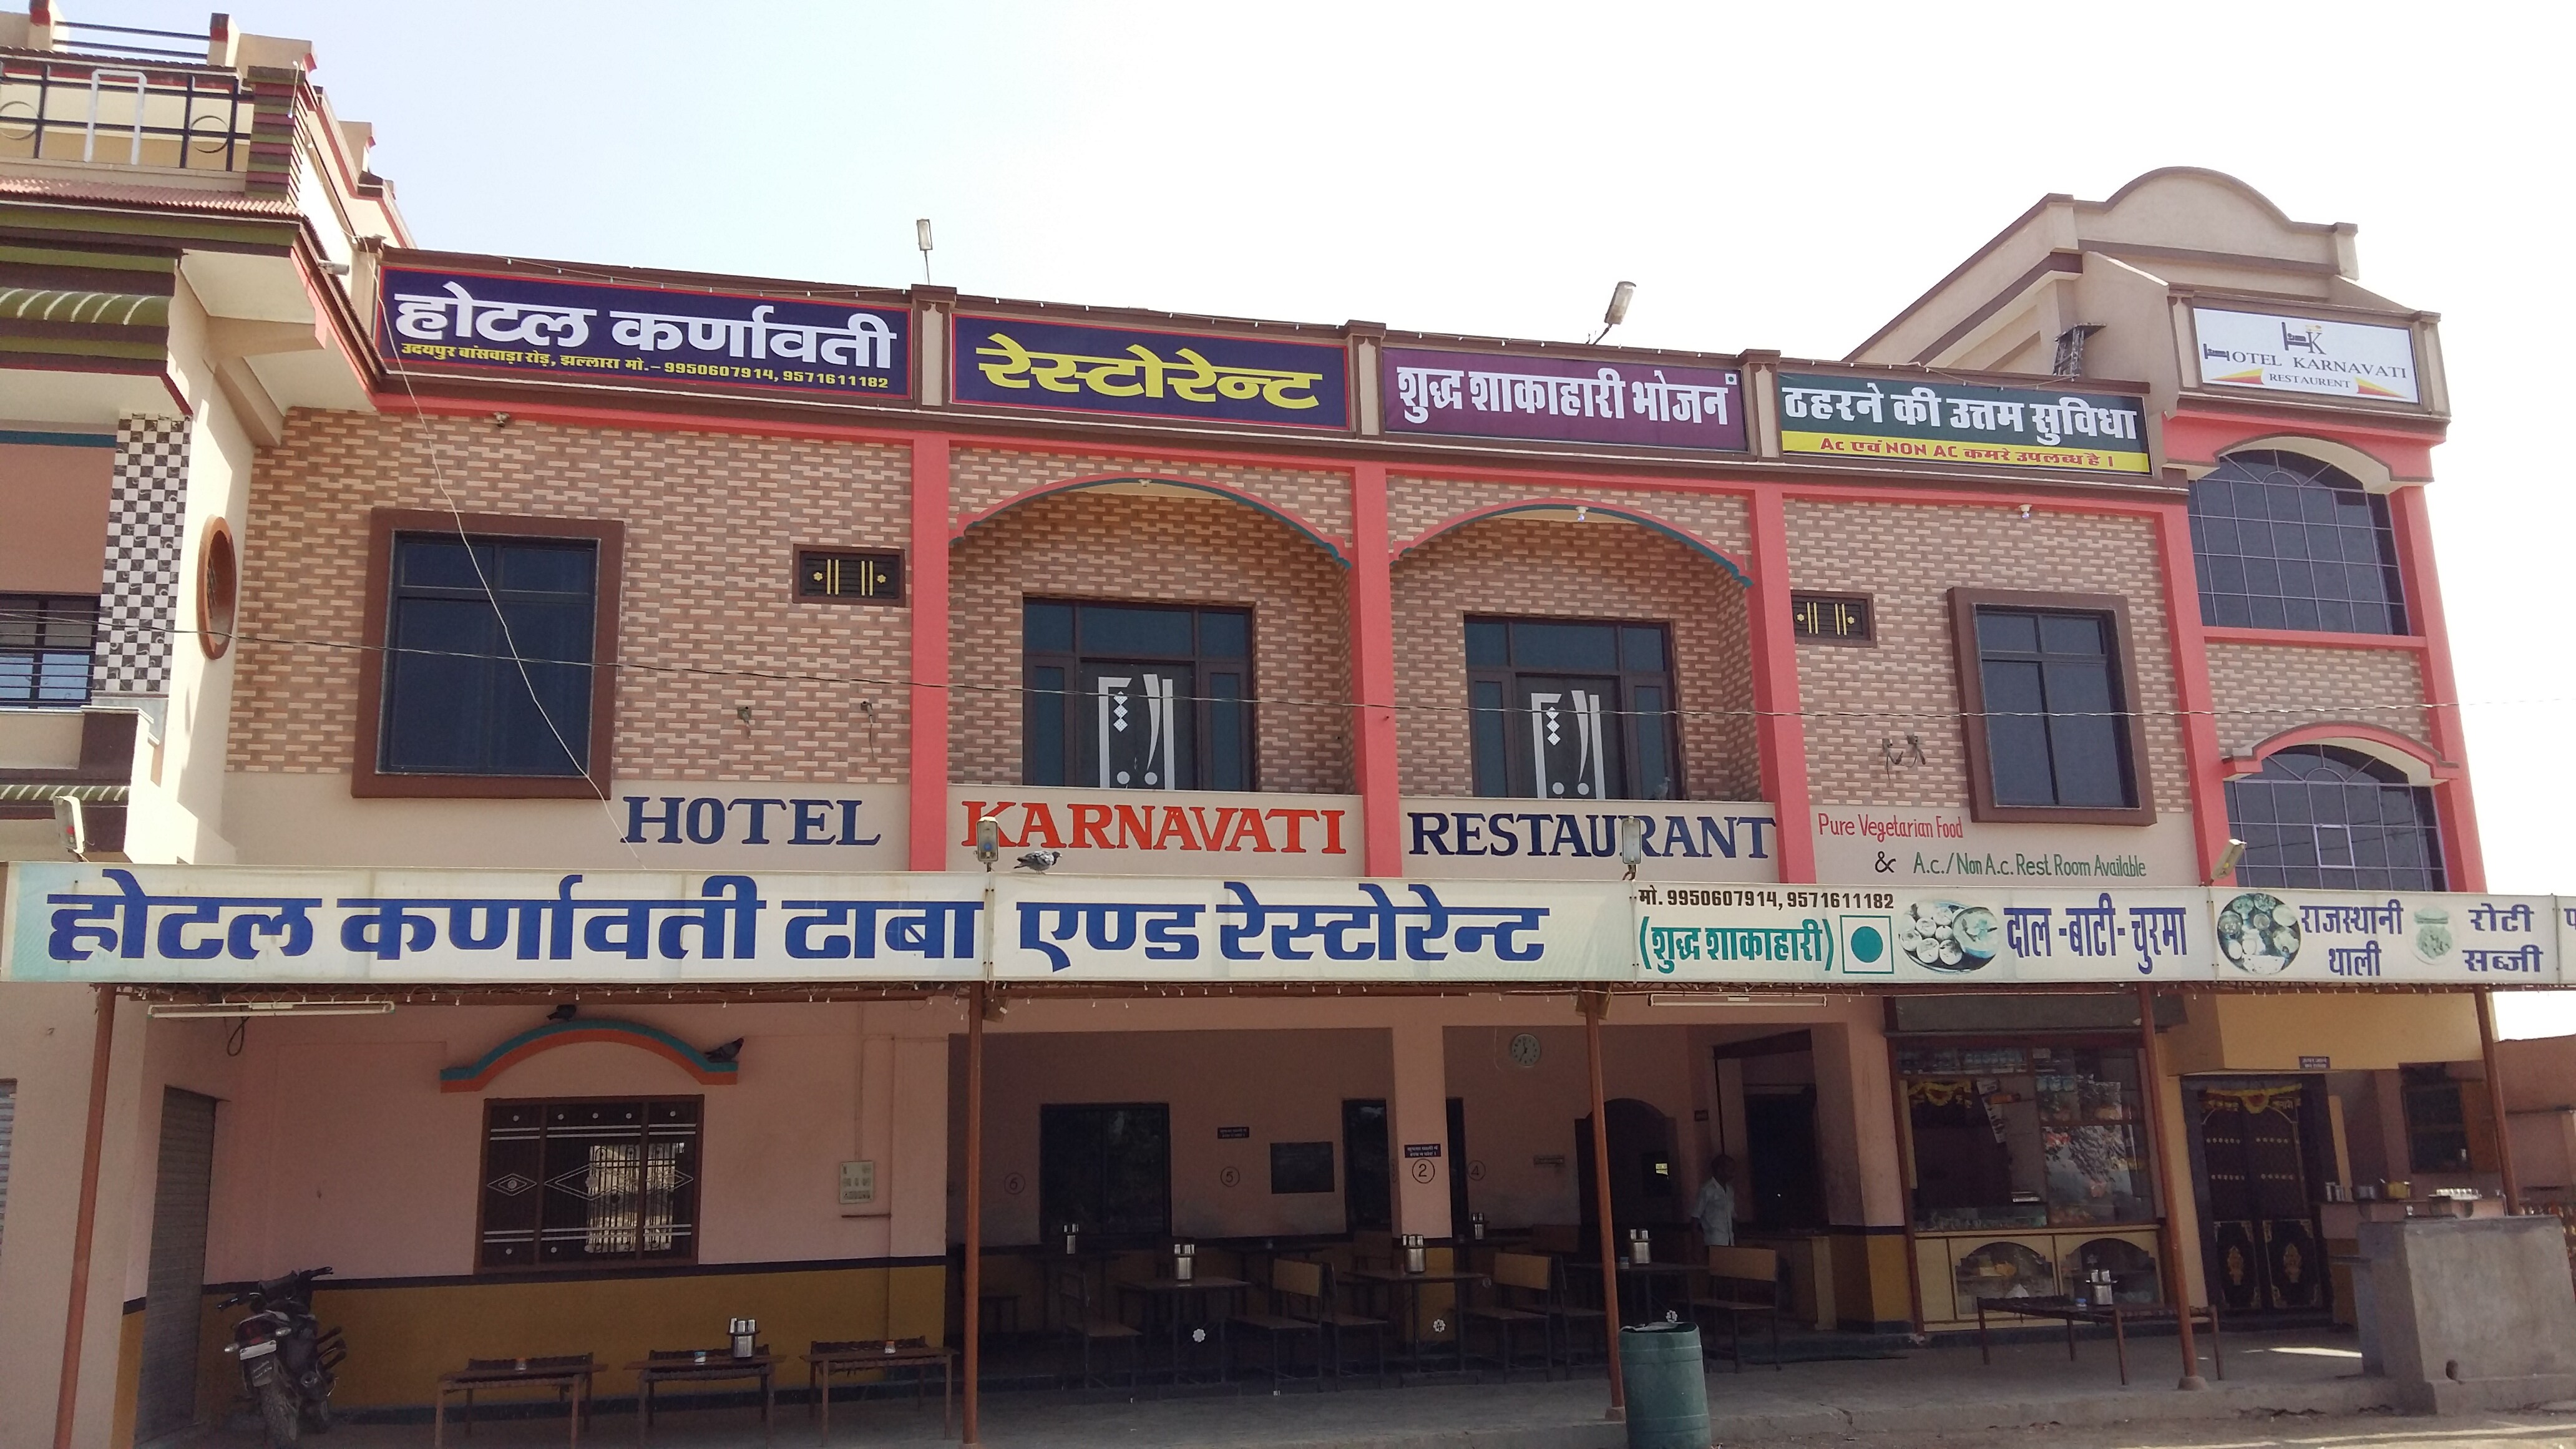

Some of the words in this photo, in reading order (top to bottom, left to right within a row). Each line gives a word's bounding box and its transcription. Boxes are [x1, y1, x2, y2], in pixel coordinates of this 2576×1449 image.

[394, 281, 597, 348] होटल
[609, 305, 897, 369] कर्णावती
[401, 342, 456, 361] उदयपुर
[458, 345, 523, 365] बांसवाड़ा
[560, 354, 620, 369] झल्लारा
[783, 371, 889, 389] 9571611182
[975, 333, 1324, 409] रेस्टोरेन्ट
[2292, 356, 2408, 379] KARNAVATI
[1396, 366, 1465, 424] शुद्ध
[1468, 367, 1626, 419] शाकाहारी
[1632, 370, 1729, 425] भोजन
[2269, 373, 2351, 389] RESTAURENT
[1781, 383, 1885, 424] ठहरने
[1890, 387, 1942, 427] की
[2029, 396, 2137, 446] सुविधा
[1850, 438, 1883, 455] एवं
[1885, 440, 1927, 457] NON
[1933, 444, 1959, 459] AC
[1963, 446, 2011, 462] कमरे
[2016, 450, 2084, 466] उपलब्ध
[619, 796, 882, 846] HOTEL
[961, 800, 1347, 854] KARNAVATI
[1407, 812, 1777, 859] RESTAURANT
[1818, 812, 1856, 837] Pure
[1858, 813, 1934, 842] Vegetarian
[1936, 816, 1964, 839] Food
[1874, 850, 1896, 874] &
[2016, 852, 2052, 876] Rest
[2053, 853, 2094, 877] Room
[2094, 854, 2147, 878] Available
[1638, 885, 1663, 907] मो.
[1787, 891, 1895, 909] 9571611182
[46, 868, 323, 961] होटल
[336, 874, 767, 960] कर्णावती
[781, 899, 985, 960] ढाबा
[1015, 901, 1206, 973] एण्ड
[1215, 881, 1551, 962] रेस्टोरेन्ट
[2299, 899, 2404, 935] राजस्थानी
[2468, 902, 2535, 932] रोटी
[2328, 940, 2382, 977] थाली
[2461, 944, 2544, 973] सब्जी
[1010, 1178, 1018, 1191] 6
[1225, 1171, 1234, 1183] 5
[1418, 1163, 1427, 1178] 2
[1470, 1165, 1480, 1176] 4
